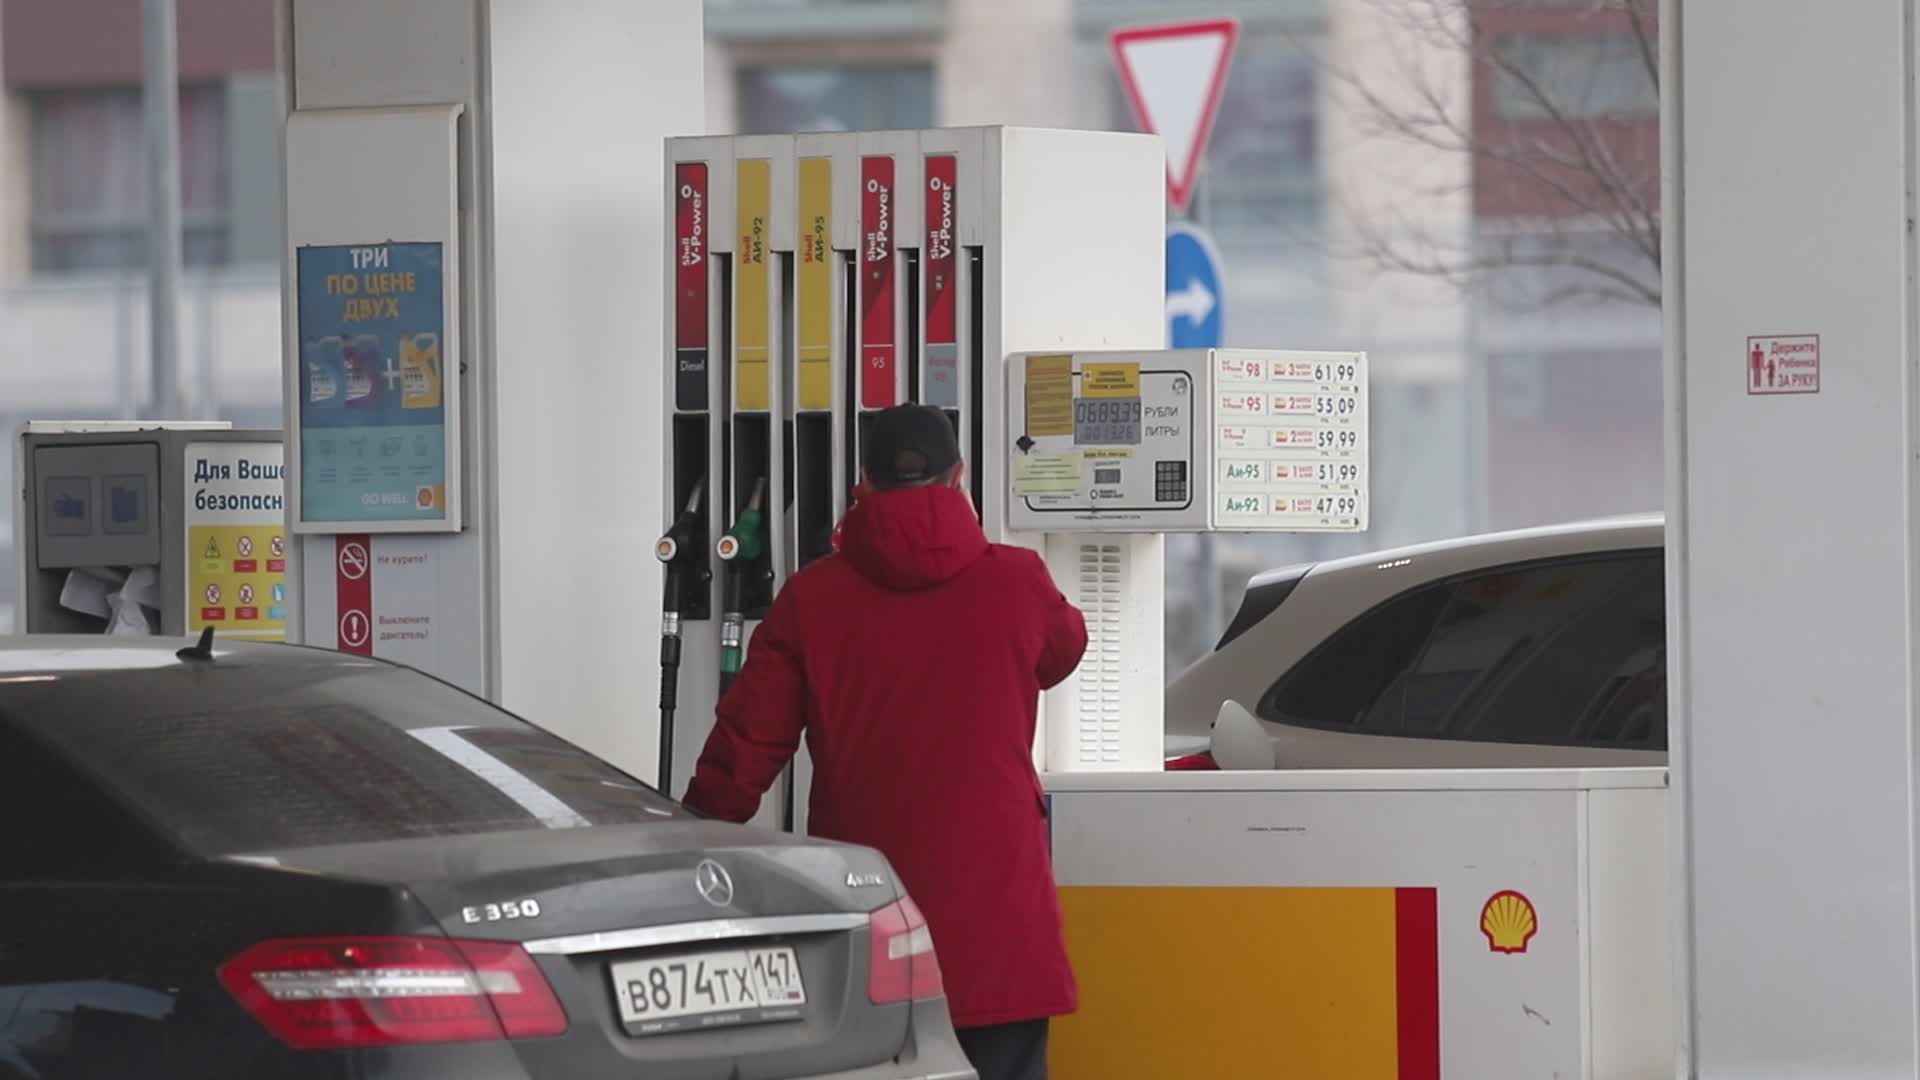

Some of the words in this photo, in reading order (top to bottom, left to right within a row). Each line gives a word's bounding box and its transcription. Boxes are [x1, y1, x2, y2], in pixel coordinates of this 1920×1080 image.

[691, 190, 702, 265] V-Power
[876, 185, 888, 260] V-Power
[940, 182, 951, 259] V-Power
[744, 236, 752, 264] Shell
[753, 217, 763, 264] АИ-92
[804, 234, 813, 263] Shell
[815, 216, 825, 263] АИ-95
[867, 233, 876, 261] Shell
[930, 231, 939, 259] Shell
[351, 248, 389, 269] ТРИ
[682, 238, 690, 266] Shell
[327, 274, 358, 295] ПО
[366, 272, 416, 296] ЦЕНЕ
[343, 297, 400, 323] ДВУХ
[871, 356, 886, 369] 95
[1246, 362, 1261, 377] 98
[1289, 363, 1295, 376] 3
[1315, 364, 1354, 382] 61,99
[1778, 374, 1791, 387] ЗА
[1144, 406, 1179, 418] РУБЛИ
[1247, 396, 1261, 411] 95
[1289, 397, 1296, 409] 2
[1317, 397, 1355, 416] 55,09
[1145, 425, 1180, 437] ЛИТРЫ
[1290, 430, 1297, 442] 2
[1318, 430, 1356, 448] 59,99
[194, 459, 231, 483] Для
[1226, 463, 1260, 478] Аи-95
[1318, 463, 1357, 482] 51,99
[195, 488, 283, 511] безопасн
[1226, 497, 1259, 512] Аи-92
[1316, 497, 1355, 516] 47,99
[462, 907, 481, 923] E
[485, 899, 540, 921] 350
[754, 952, 789, 987] 147
